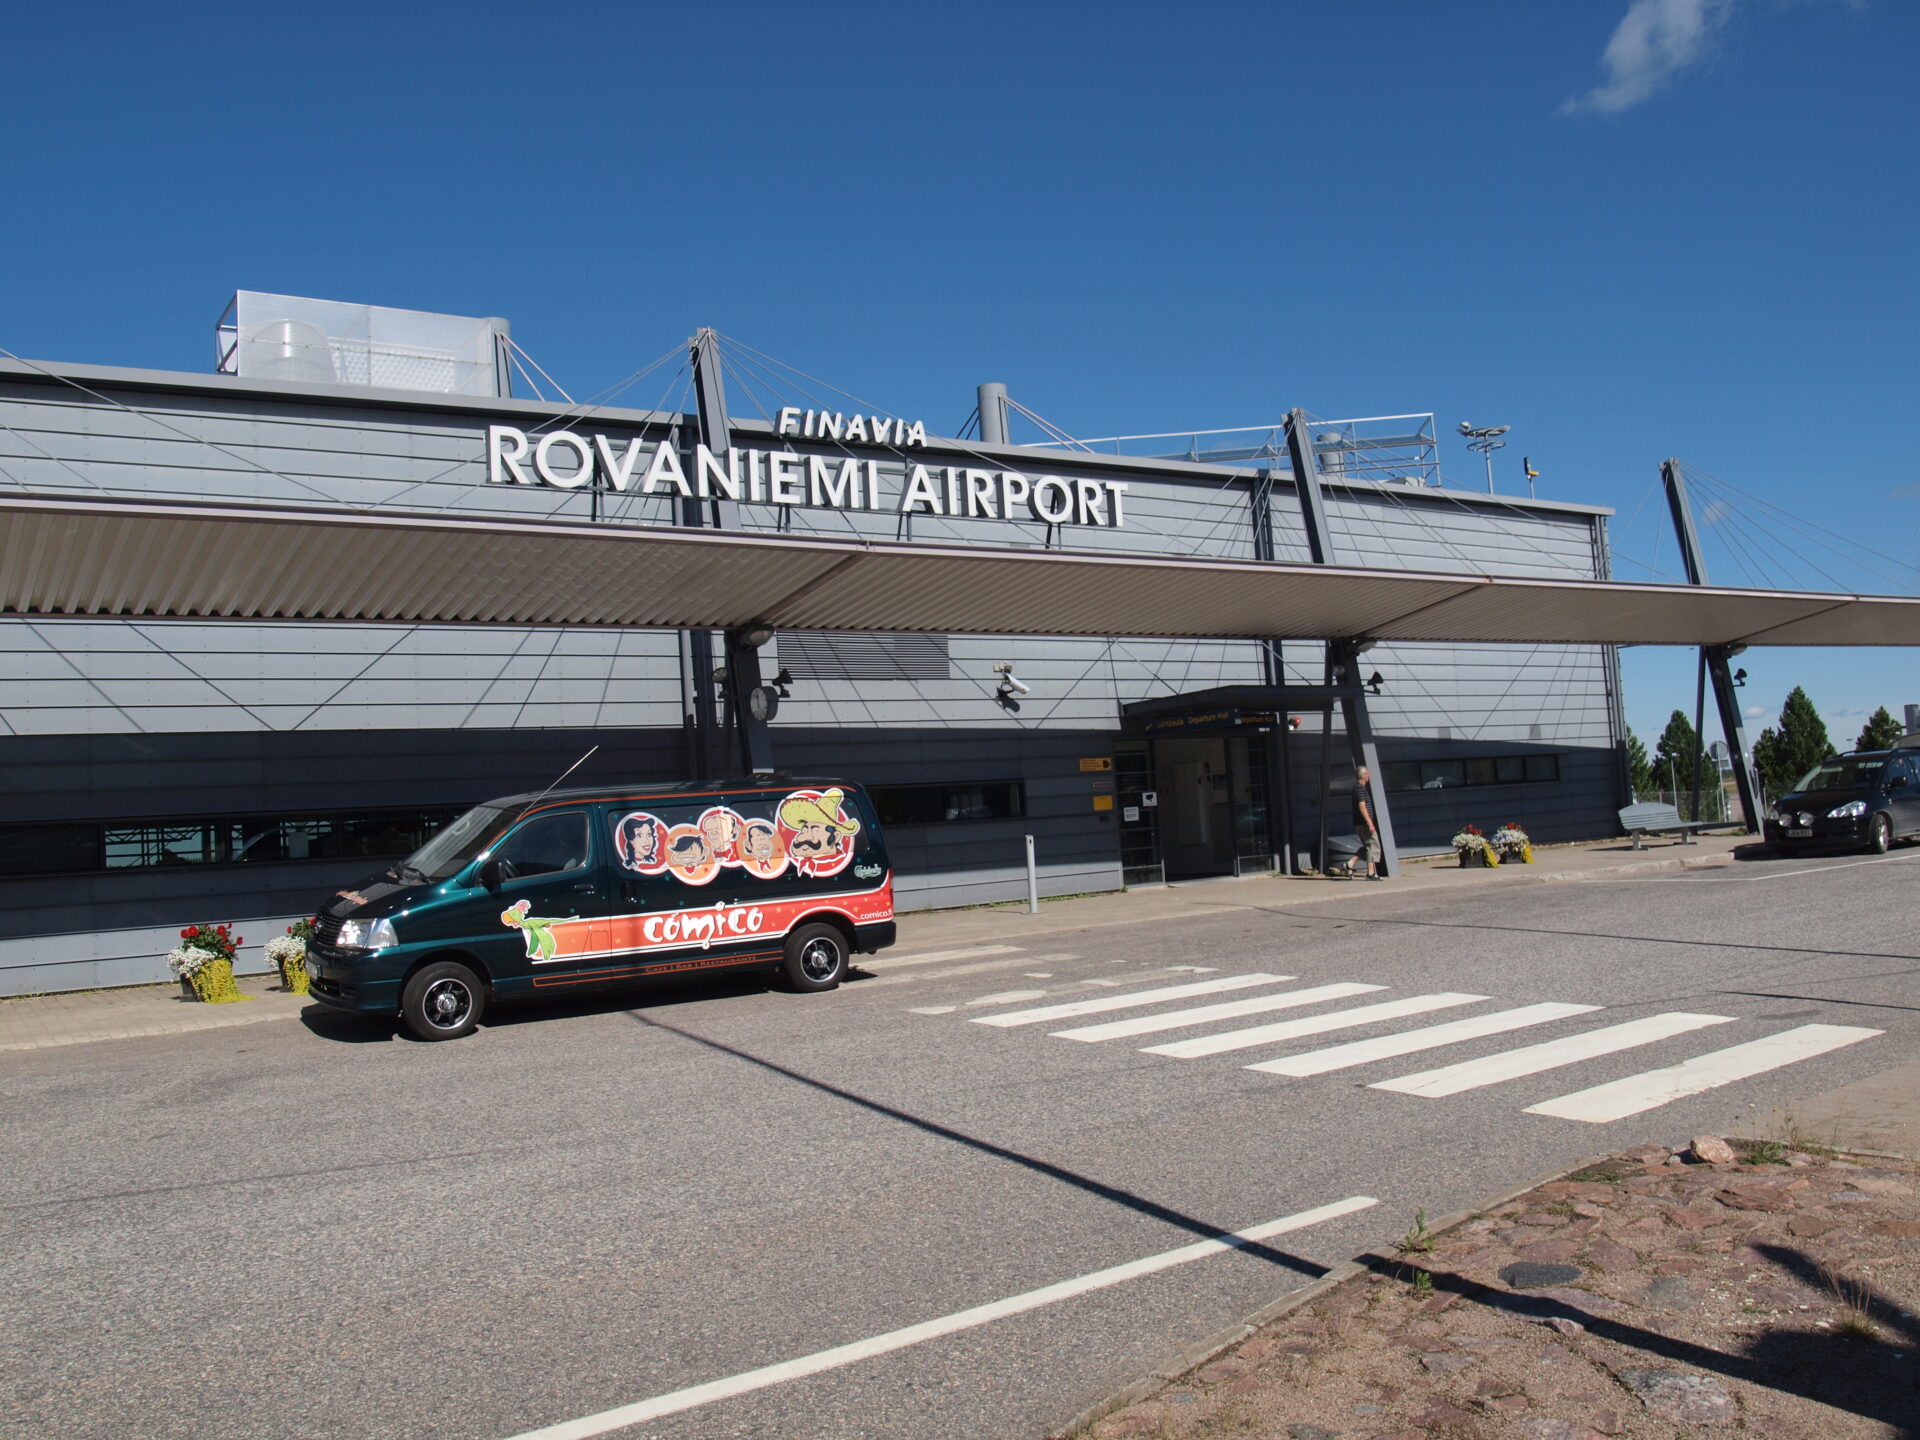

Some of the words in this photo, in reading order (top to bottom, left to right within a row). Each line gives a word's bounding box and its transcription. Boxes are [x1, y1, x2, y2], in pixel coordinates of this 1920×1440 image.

[774, 407, 928, 448] FINAVIA
[487, 424, 880, 510] ROVANIEMI
[902, 462, 1129, 528] AIRPORT
